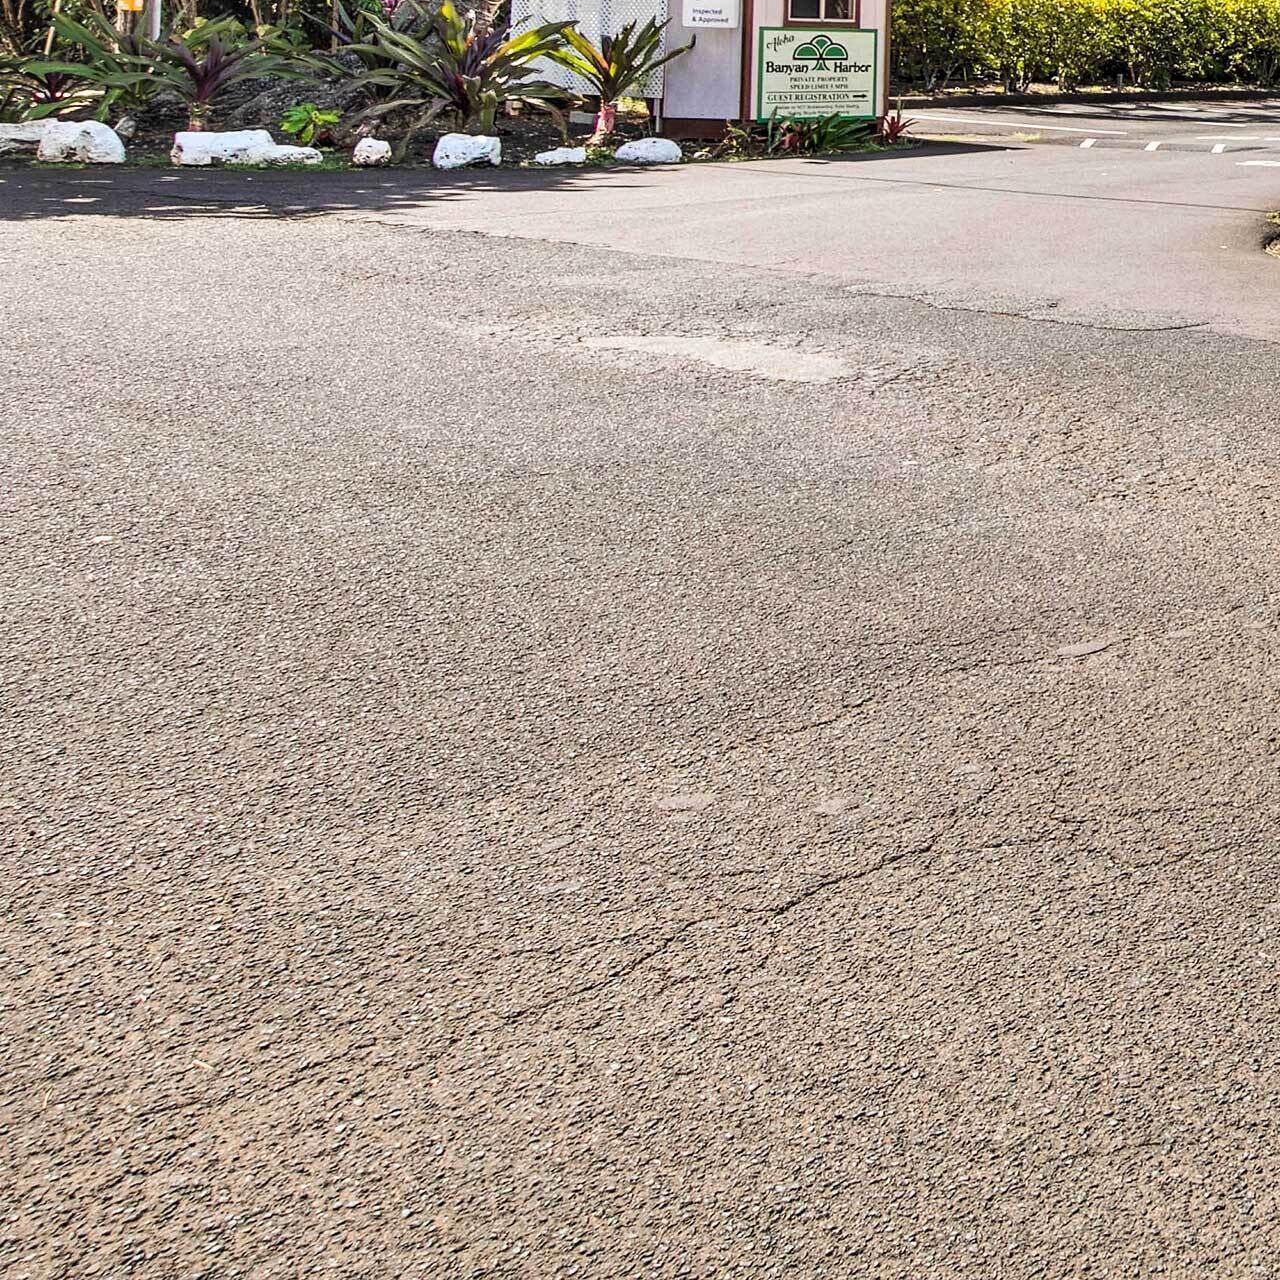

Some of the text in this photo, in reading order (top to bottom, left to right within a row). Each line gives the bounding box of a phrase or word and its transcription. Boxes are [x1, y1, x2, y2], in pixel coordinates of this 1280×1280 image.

[766, 34, 795, 52] Aloha
[766, 61, 872, 75] Banyan Harbor
[767, 93, 850, 102] GUEST REGISTRATION
